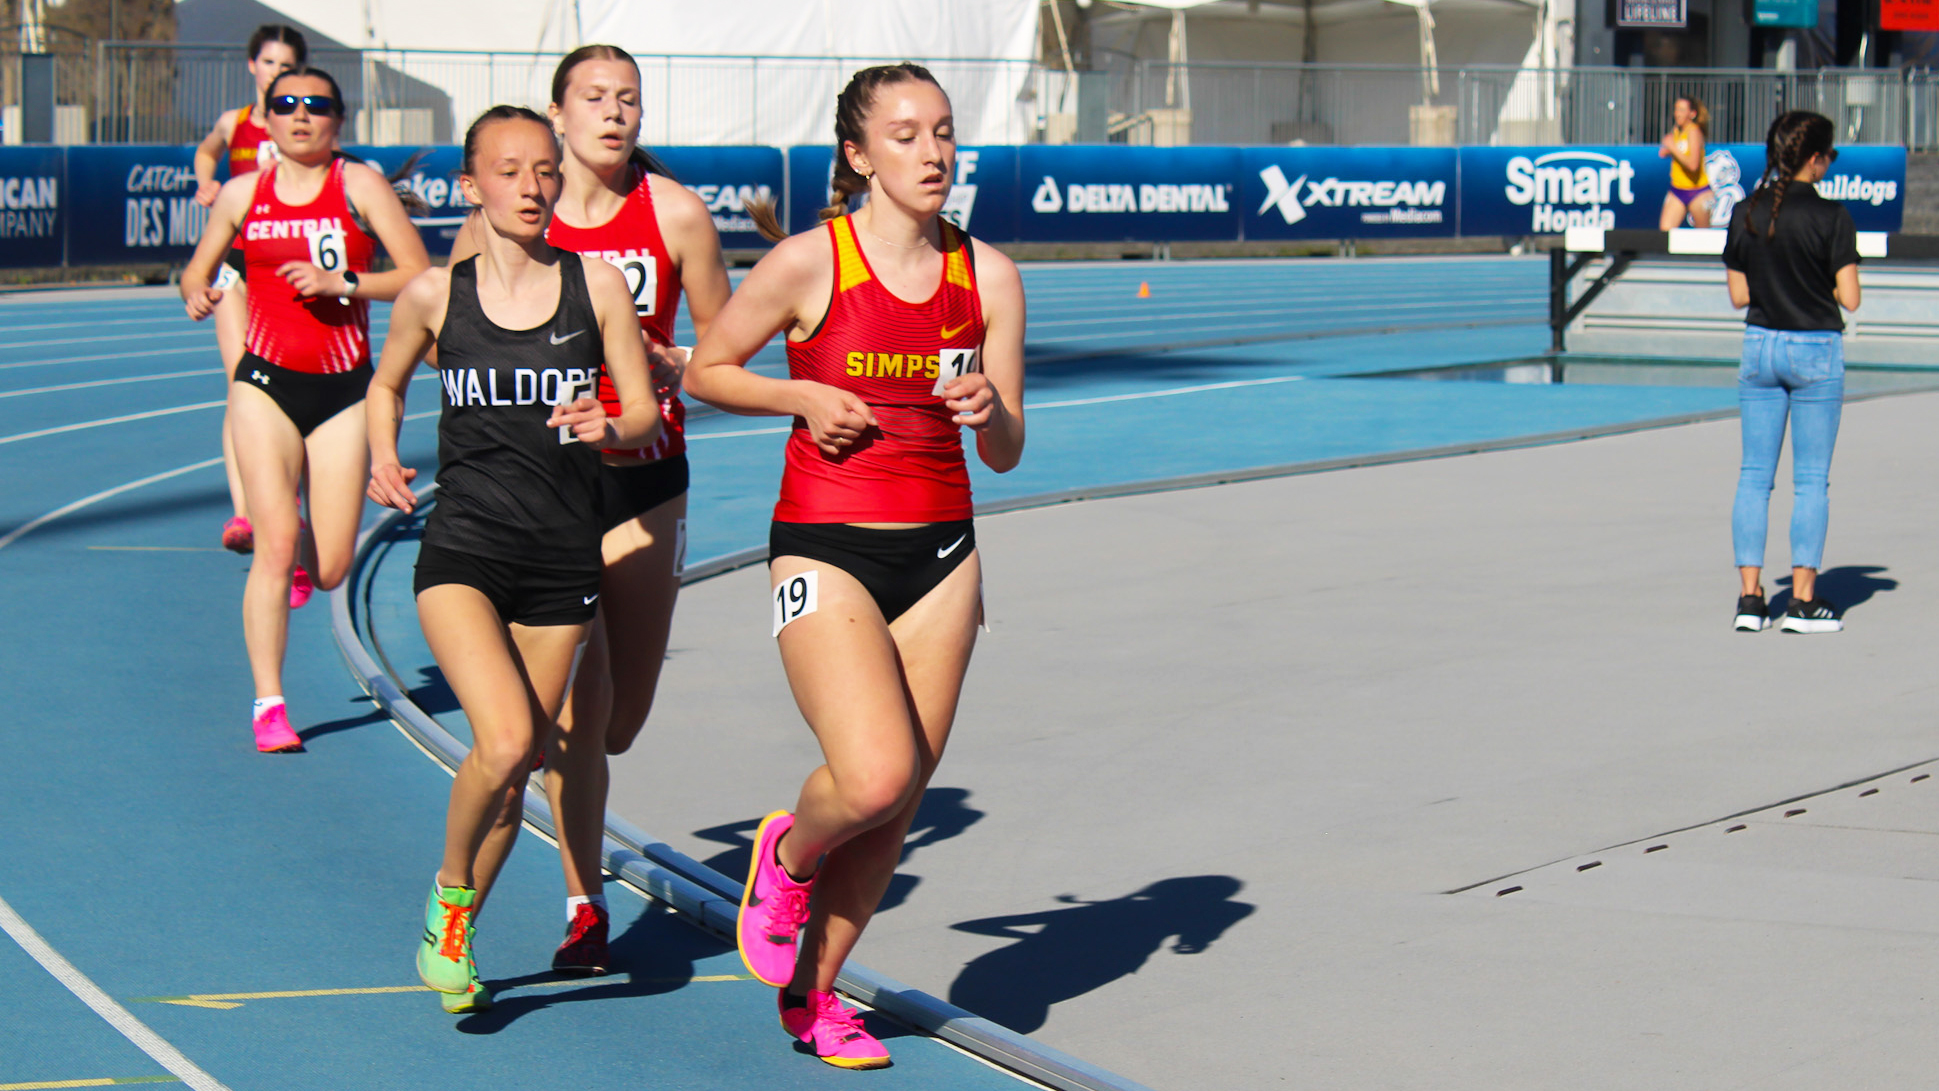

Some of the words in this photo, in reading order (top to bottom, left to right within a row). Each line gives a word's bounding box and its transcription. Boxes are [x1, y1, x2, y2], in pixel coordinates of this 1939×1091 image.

[1625, 5, 1677, 22] LIFELINE
[127, 164, 190, 192] CATCH
[1303, 177, 1446, 207] XTREAM
[1505, 156, 1635, 205] Smart
[684, 184, 771, 213] EAM
[1067, 184, 1137, 212] DELTA
[1139, 184, 1230, 212] DENTAL
[126, 197, 164, 247] DES
[1532, 204, 1616, 232] Honda
[319, 234, 338, 271] 6
[624, 261, 648, 312] 2
[845, 351, 940, 379] SIMPS
[777, 577, 808, 623] 19
